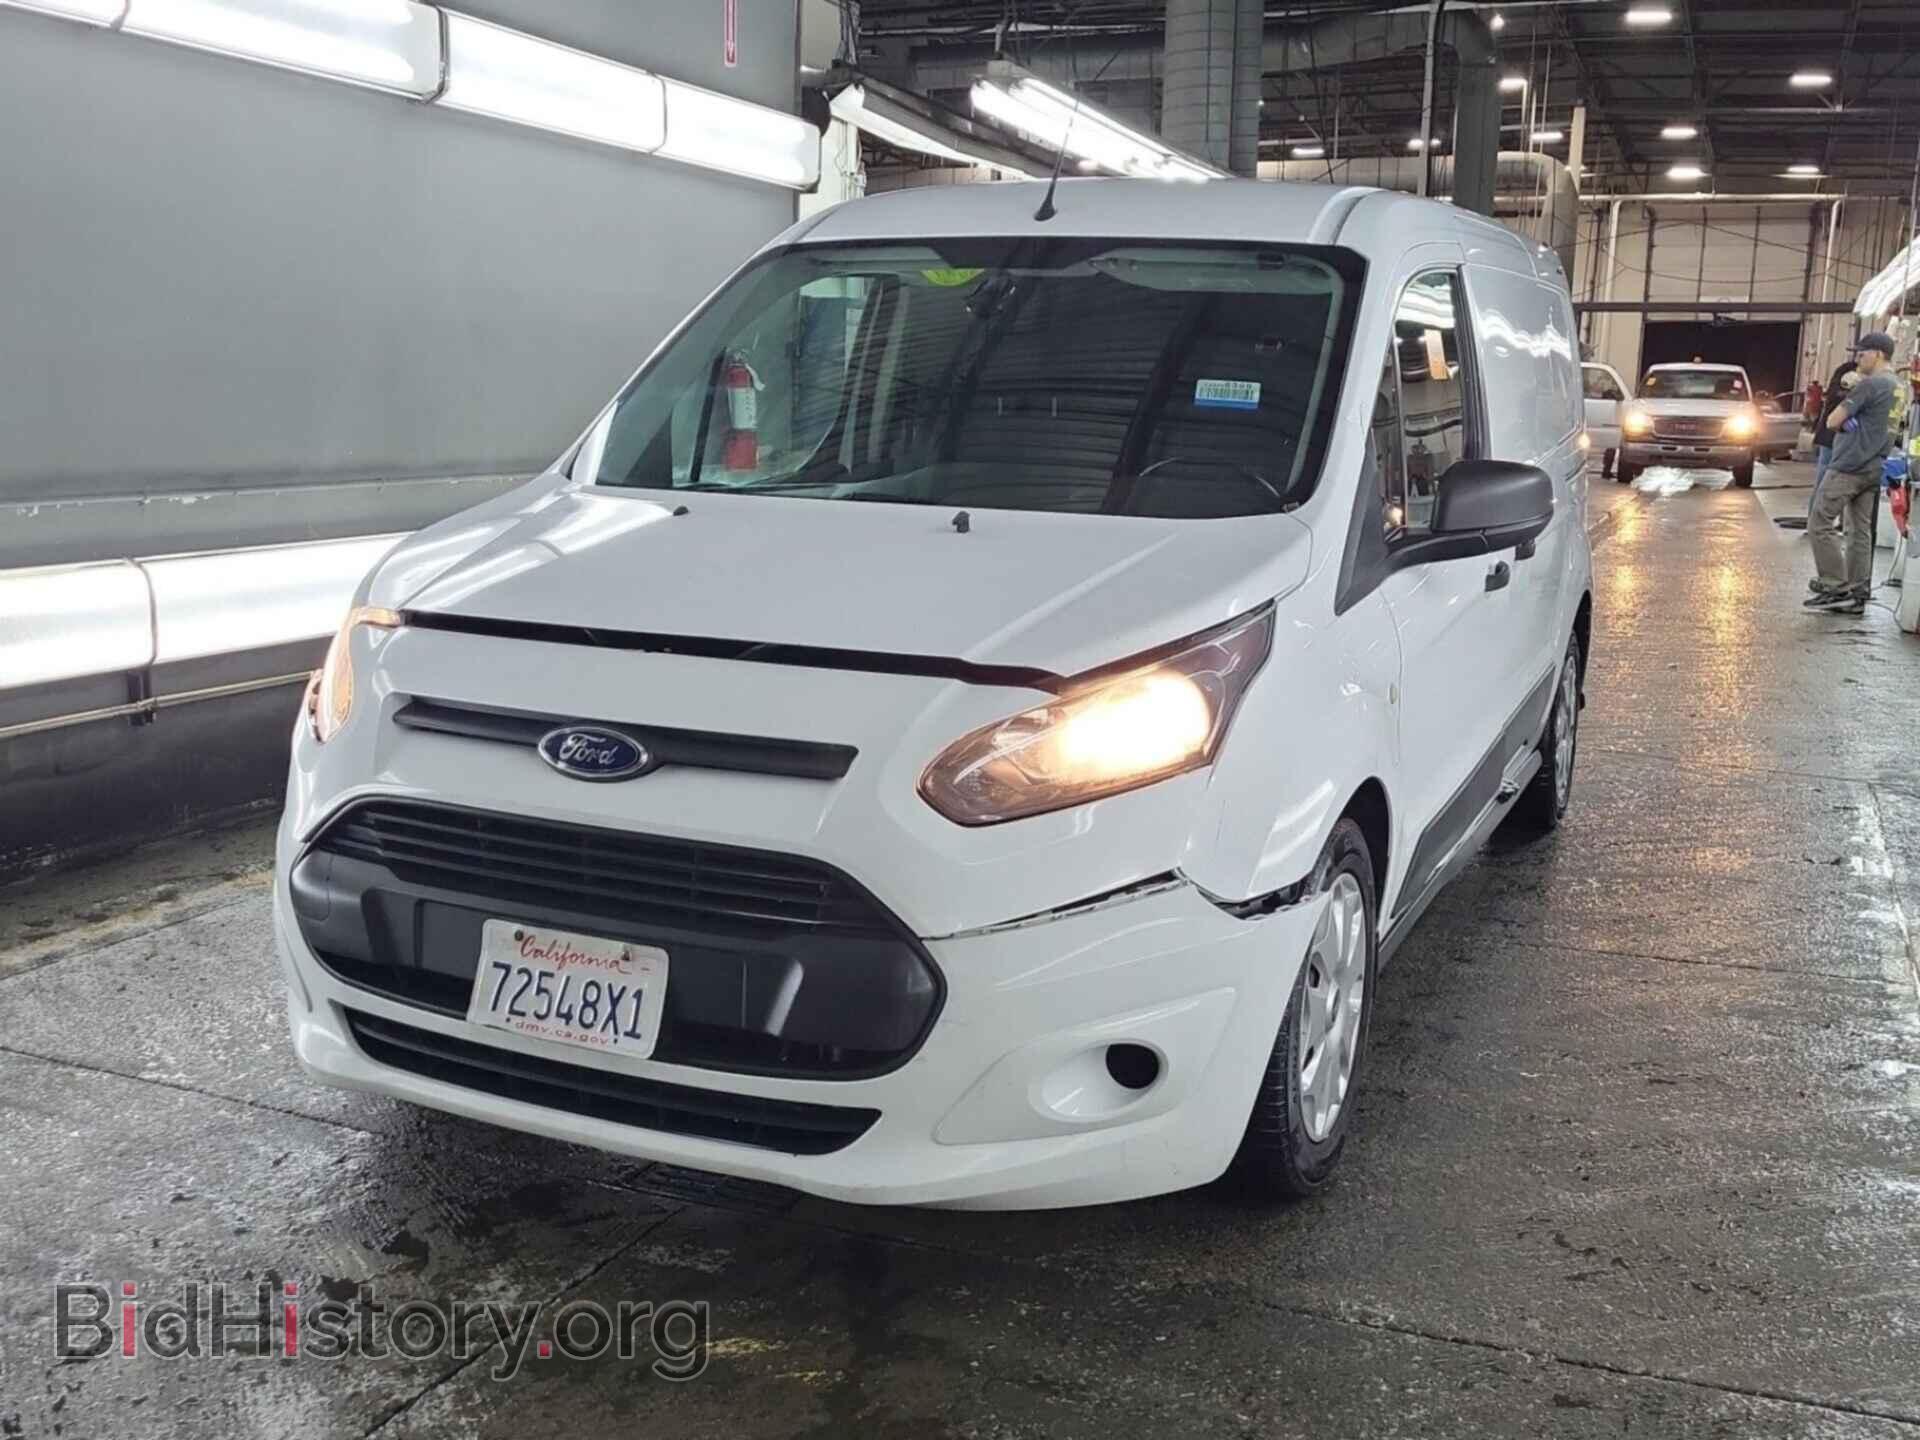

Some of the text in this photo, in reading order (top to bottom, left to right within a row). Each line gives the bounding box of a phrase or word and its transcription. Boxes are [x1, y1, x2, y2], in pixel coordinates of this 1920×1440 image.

[559, 733, 618, 765] Ford
[519, 934, 632, 975] California
[490, 961, 644, 1040] 72548X1
[514, 1020, 609, 1045] dmv.ca.gov
